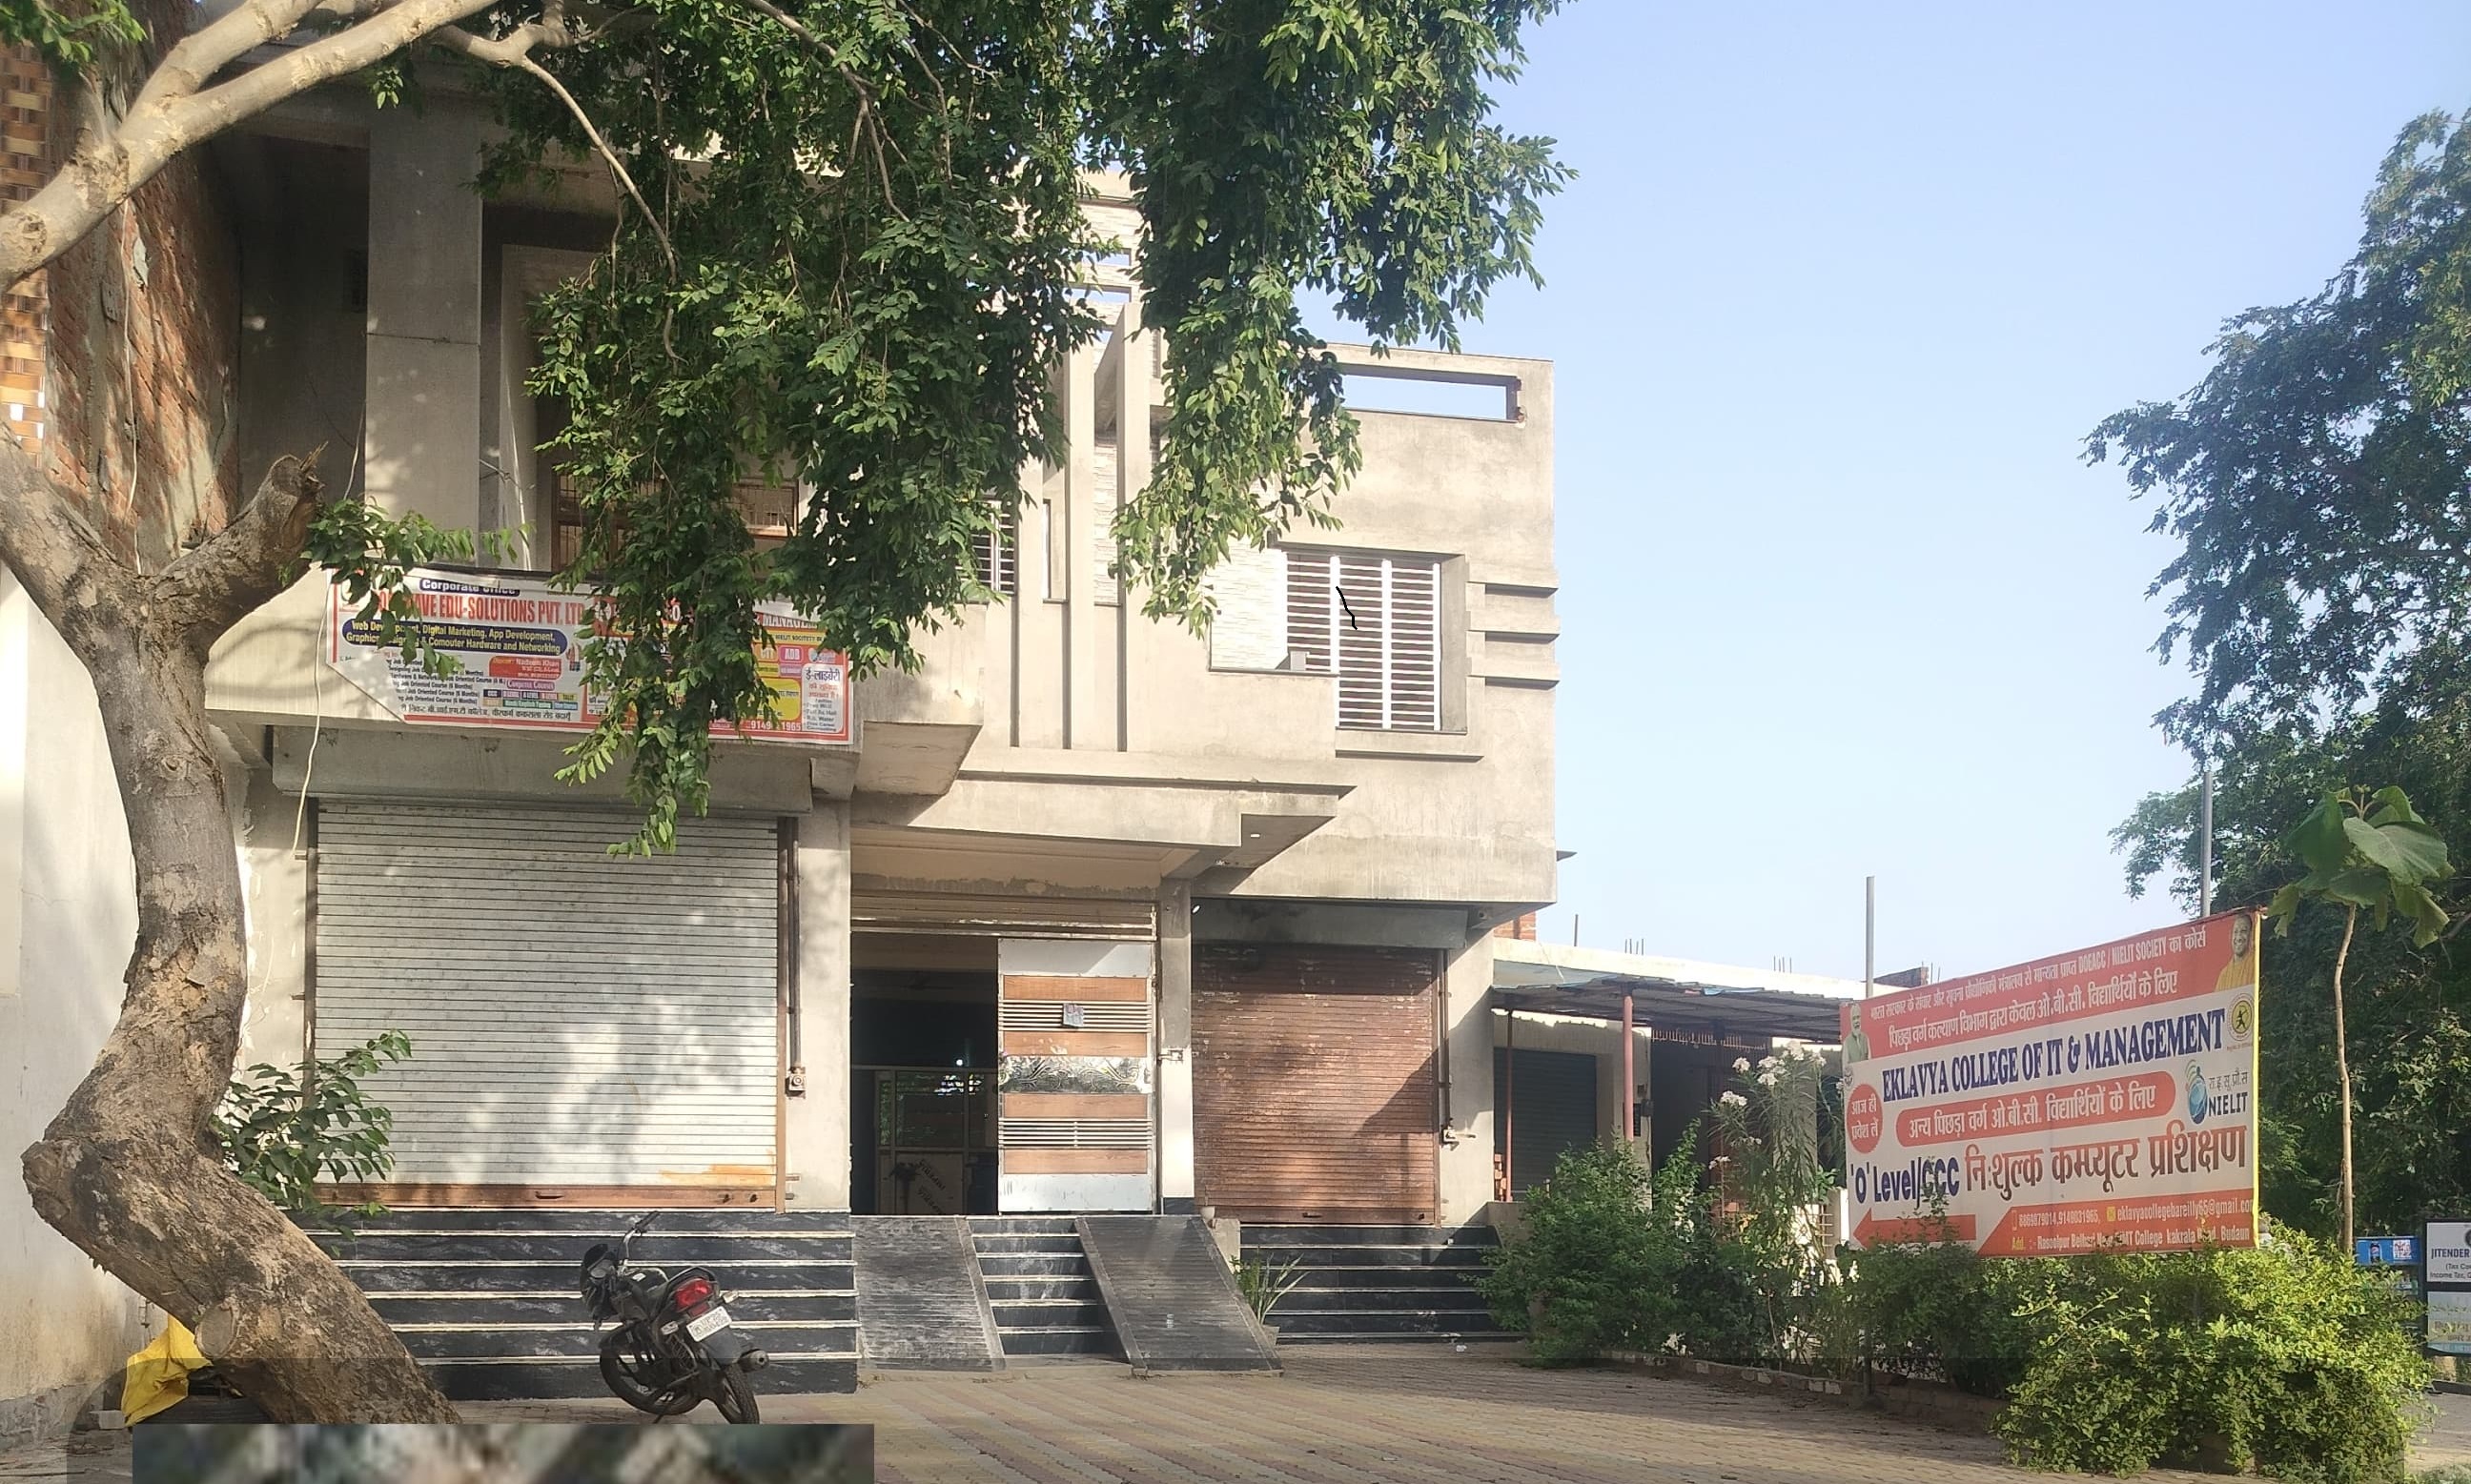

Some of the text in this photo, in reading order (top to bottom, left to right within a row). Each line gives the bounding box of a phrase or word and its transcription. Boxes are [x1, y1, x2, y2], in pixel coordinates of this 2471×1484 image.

[439, 594, 535, 623] EDU-SOLUTIONS
[352, 620, 369, 632] Web
[422, 624, 447, 638] Digital
[488, 628, 504, 640] App
[466, 639, 502, 650] Hardware
[503, 640, 518, 650] and
[519, 641, 562, 655] Networking
[2078, 950, 2106, 974] DOEACC
[2112, 943, 2134, 966] NIELIT
[2135, 937, 2167, 961] SOCIETY
[2169, 936, 2182, 953] का
[1928, 1017, 1959, 1040] कल्याण
[1959, 1009, 1988, 1034] विभाग
[2009, 1000, 2036, 1024] केवल
[2138, 971, 2153, 999] के
[2154, 966, 2179, 995] लिए
[1882, 1060, 1950, 1103] EKLAVYA
[1951, 1047, 2019, 1091] COLLEGE
[2022, 1042, 2043, 1081] OF
[2046, 1039, 2063, 1077] IT
[2068, 1035, 2081, 1073] &
[2085, 1008, 2226, 1070] MANAGEMENT
[1851, 1093, 1877, 1115] आज ही
[1909, 1115, 1931, 1139] अन्य
[1968, 1102, 1988, 1131] वर्ग
[2109, 1082, 2124, 1113] के
[2128, 1080, 2156, 1111] लिए
[2208, 1091, 2249, 1117] NIELIT
[2147, 1119, 2248, 1178] प्रशिक्षण
[2134, 1230, 2163, 1248] College
[2220, 1224, 2250, 1242] Budaun
[2431, 1248, 2470, 1260] JITENDER
